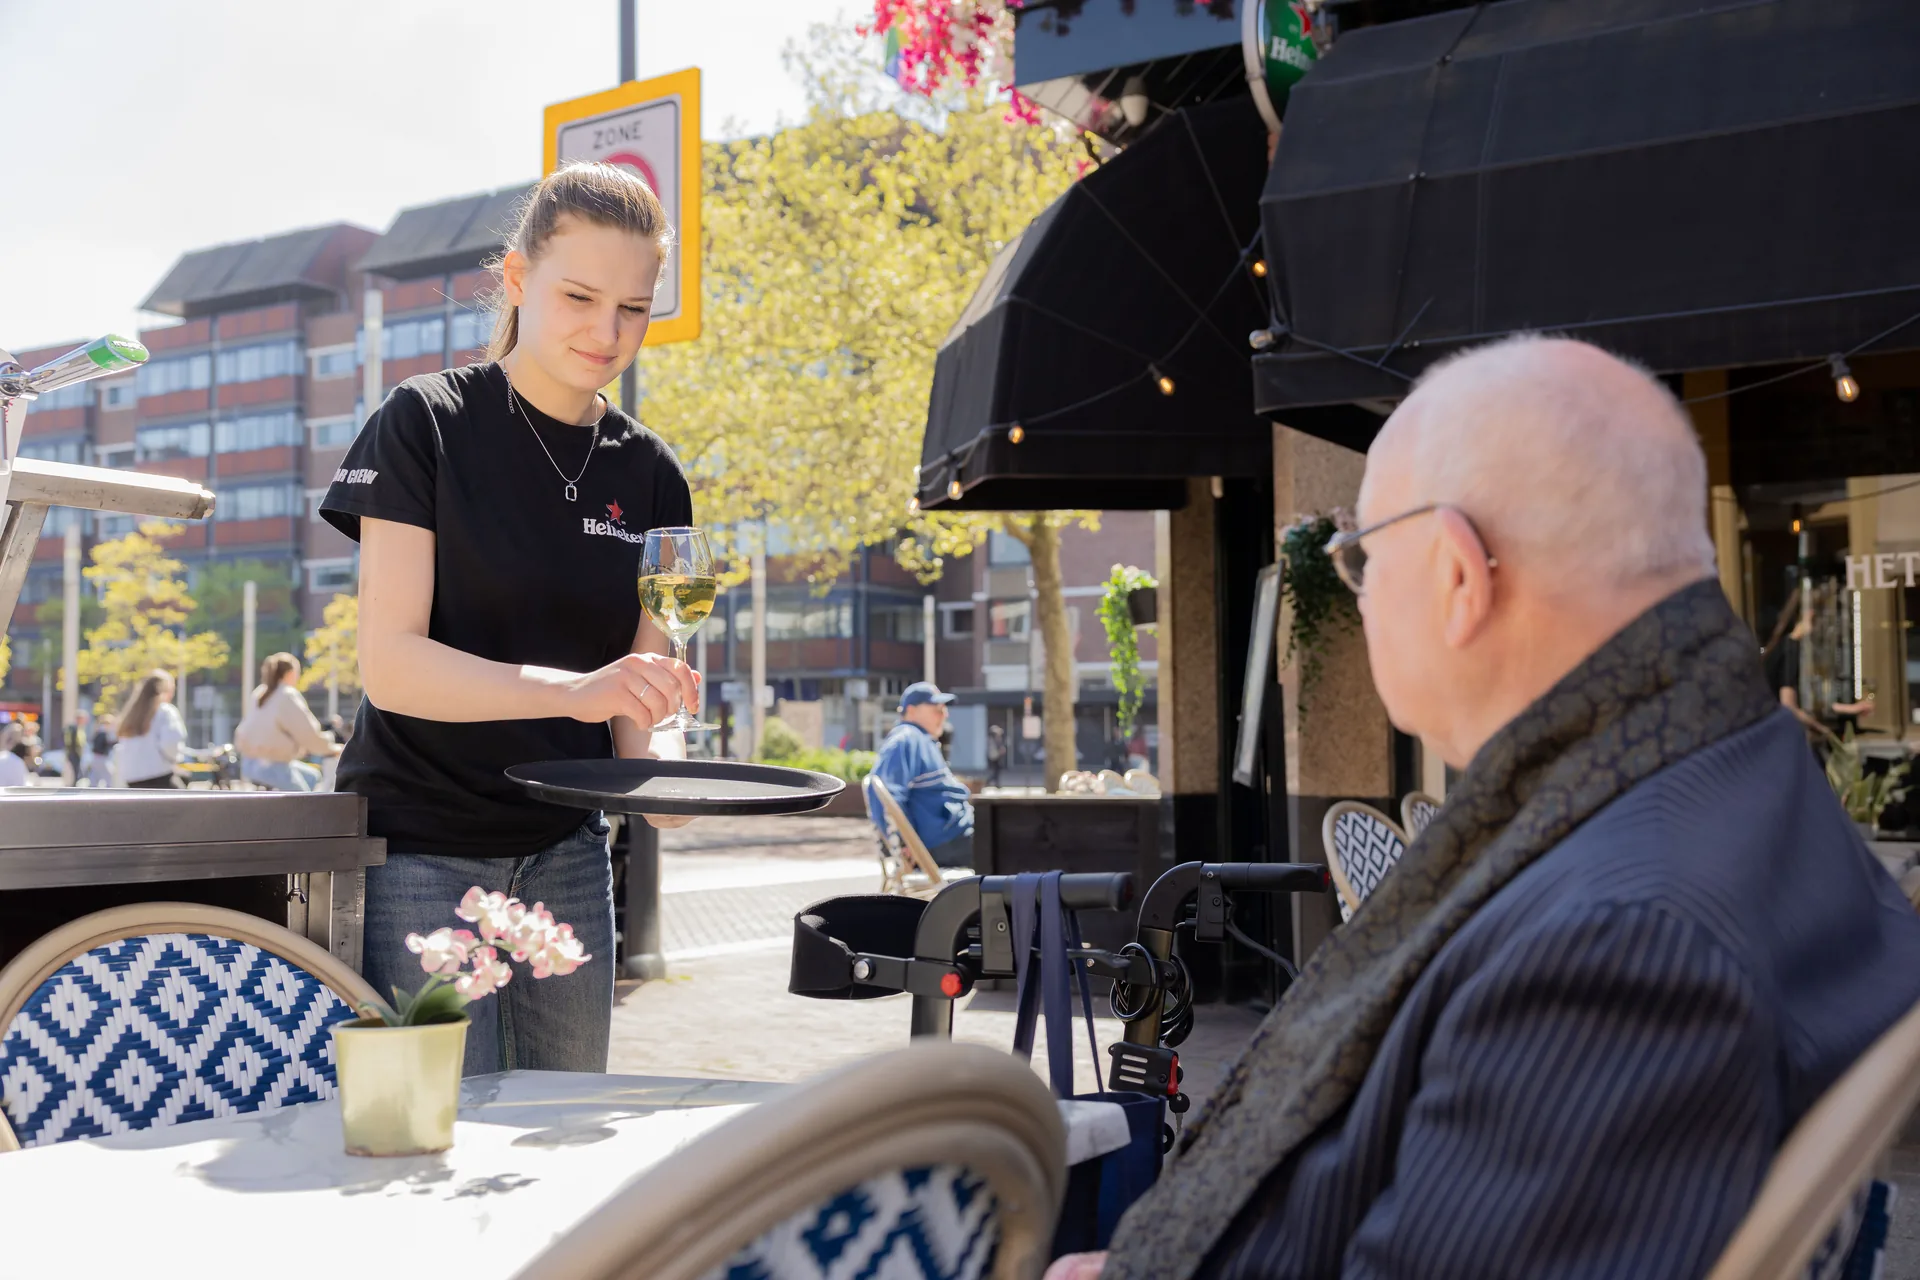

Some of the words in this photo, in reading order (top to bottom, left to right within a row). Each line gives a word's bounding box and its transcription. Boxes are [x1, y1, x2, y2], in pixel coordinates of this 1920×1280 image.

[593, 120, 643, 150] ZONE
[332, 468, 349, 483] AR
[1845, 552, 1920, 590] HET
